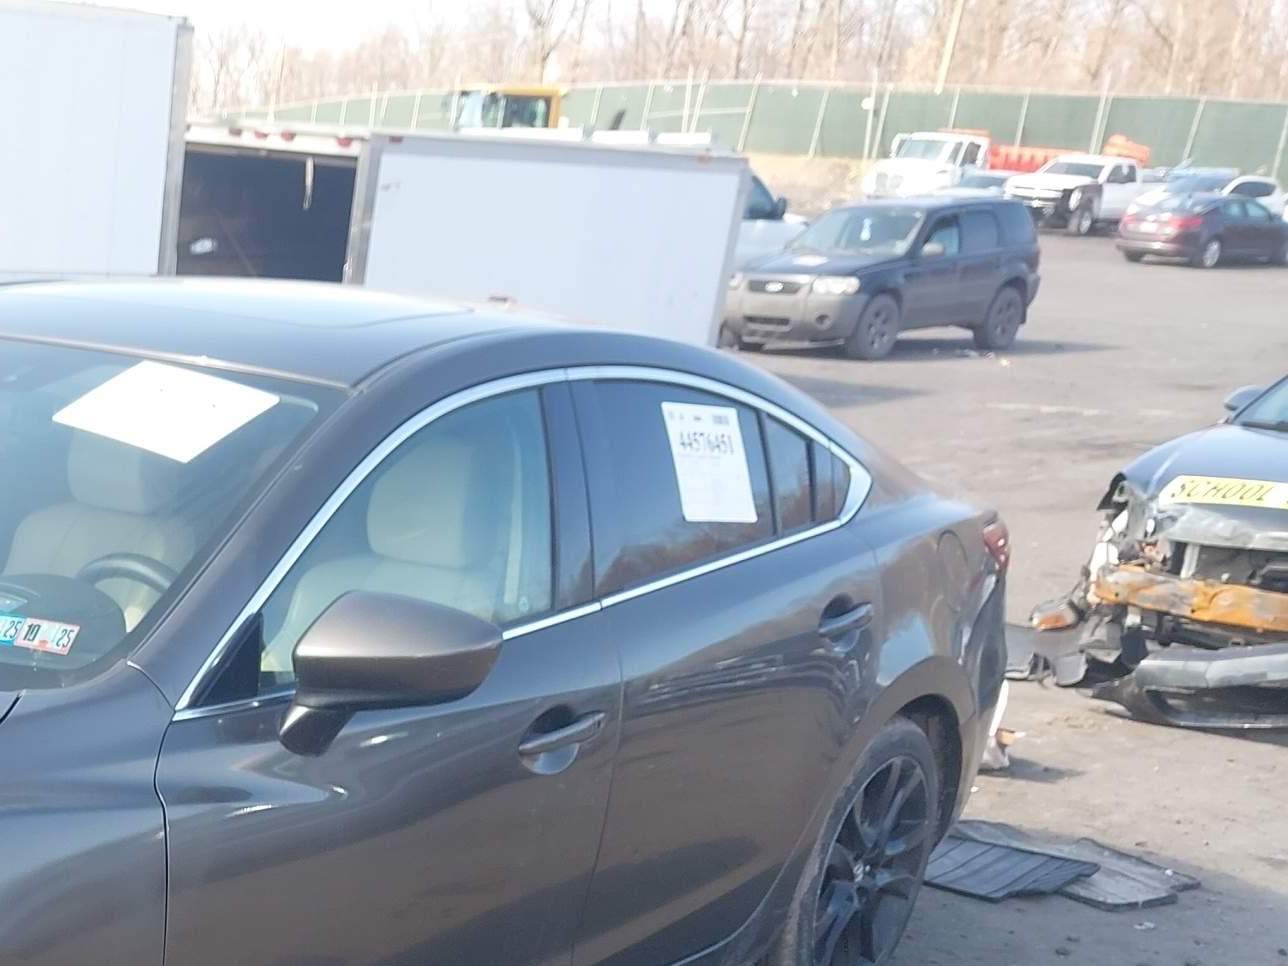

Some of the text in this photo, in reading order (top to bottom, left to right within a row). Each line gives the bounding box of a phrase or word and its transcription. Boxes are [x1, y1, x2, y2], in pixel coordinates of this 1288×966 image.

[679, 431, 735, 455] 44576451
[1171, 479, 1274, 501] SCHOOL
[3, 620, 22, 639] 25
[22, 623, 75, 648] 10 25
